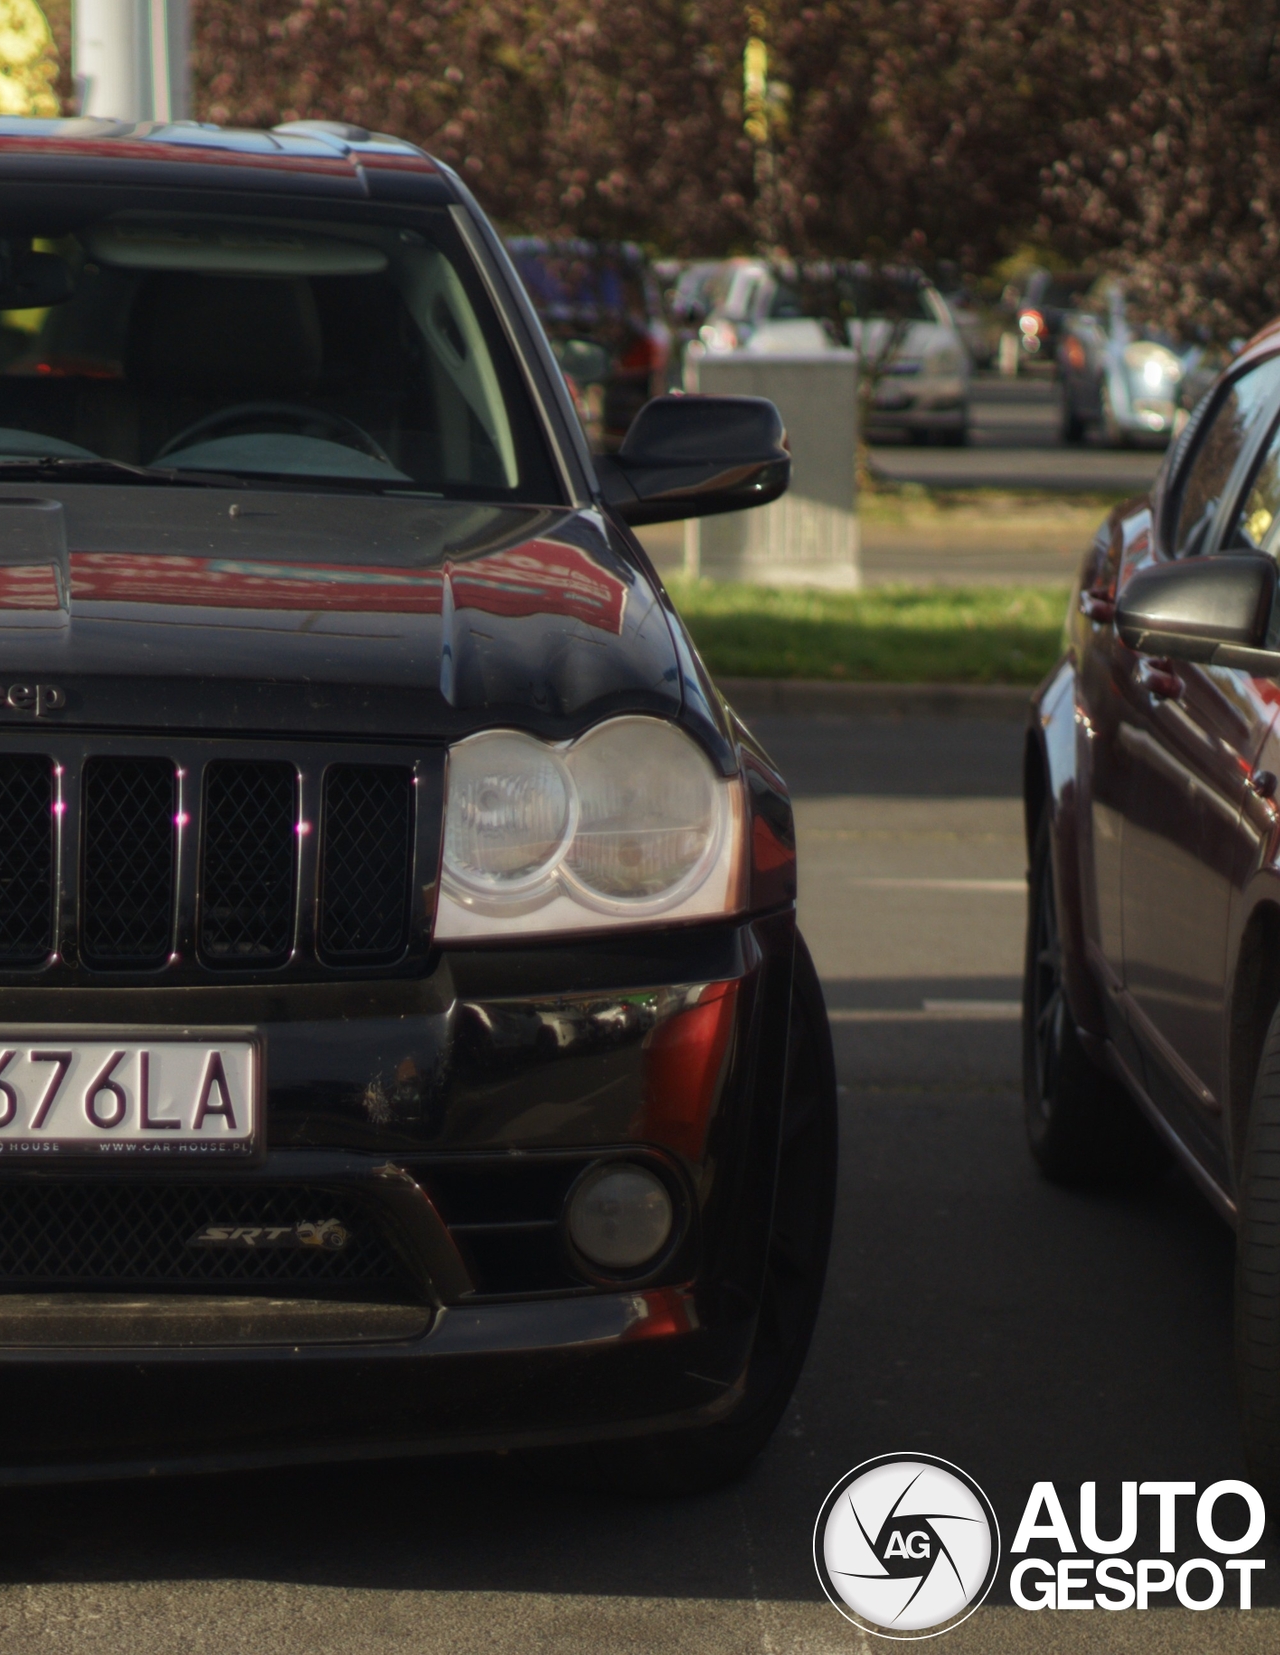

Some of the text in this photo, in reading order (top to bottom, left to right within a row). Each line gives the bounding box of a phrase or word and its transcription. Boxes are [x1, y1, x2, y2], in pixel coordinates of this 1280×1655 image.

[9, 1142, 60, 1151] HOUSE
[99, 1142, 249, 1152] WWW.CAR-HOUSE.PL
[198, 1227, 293, 1246] SRT
